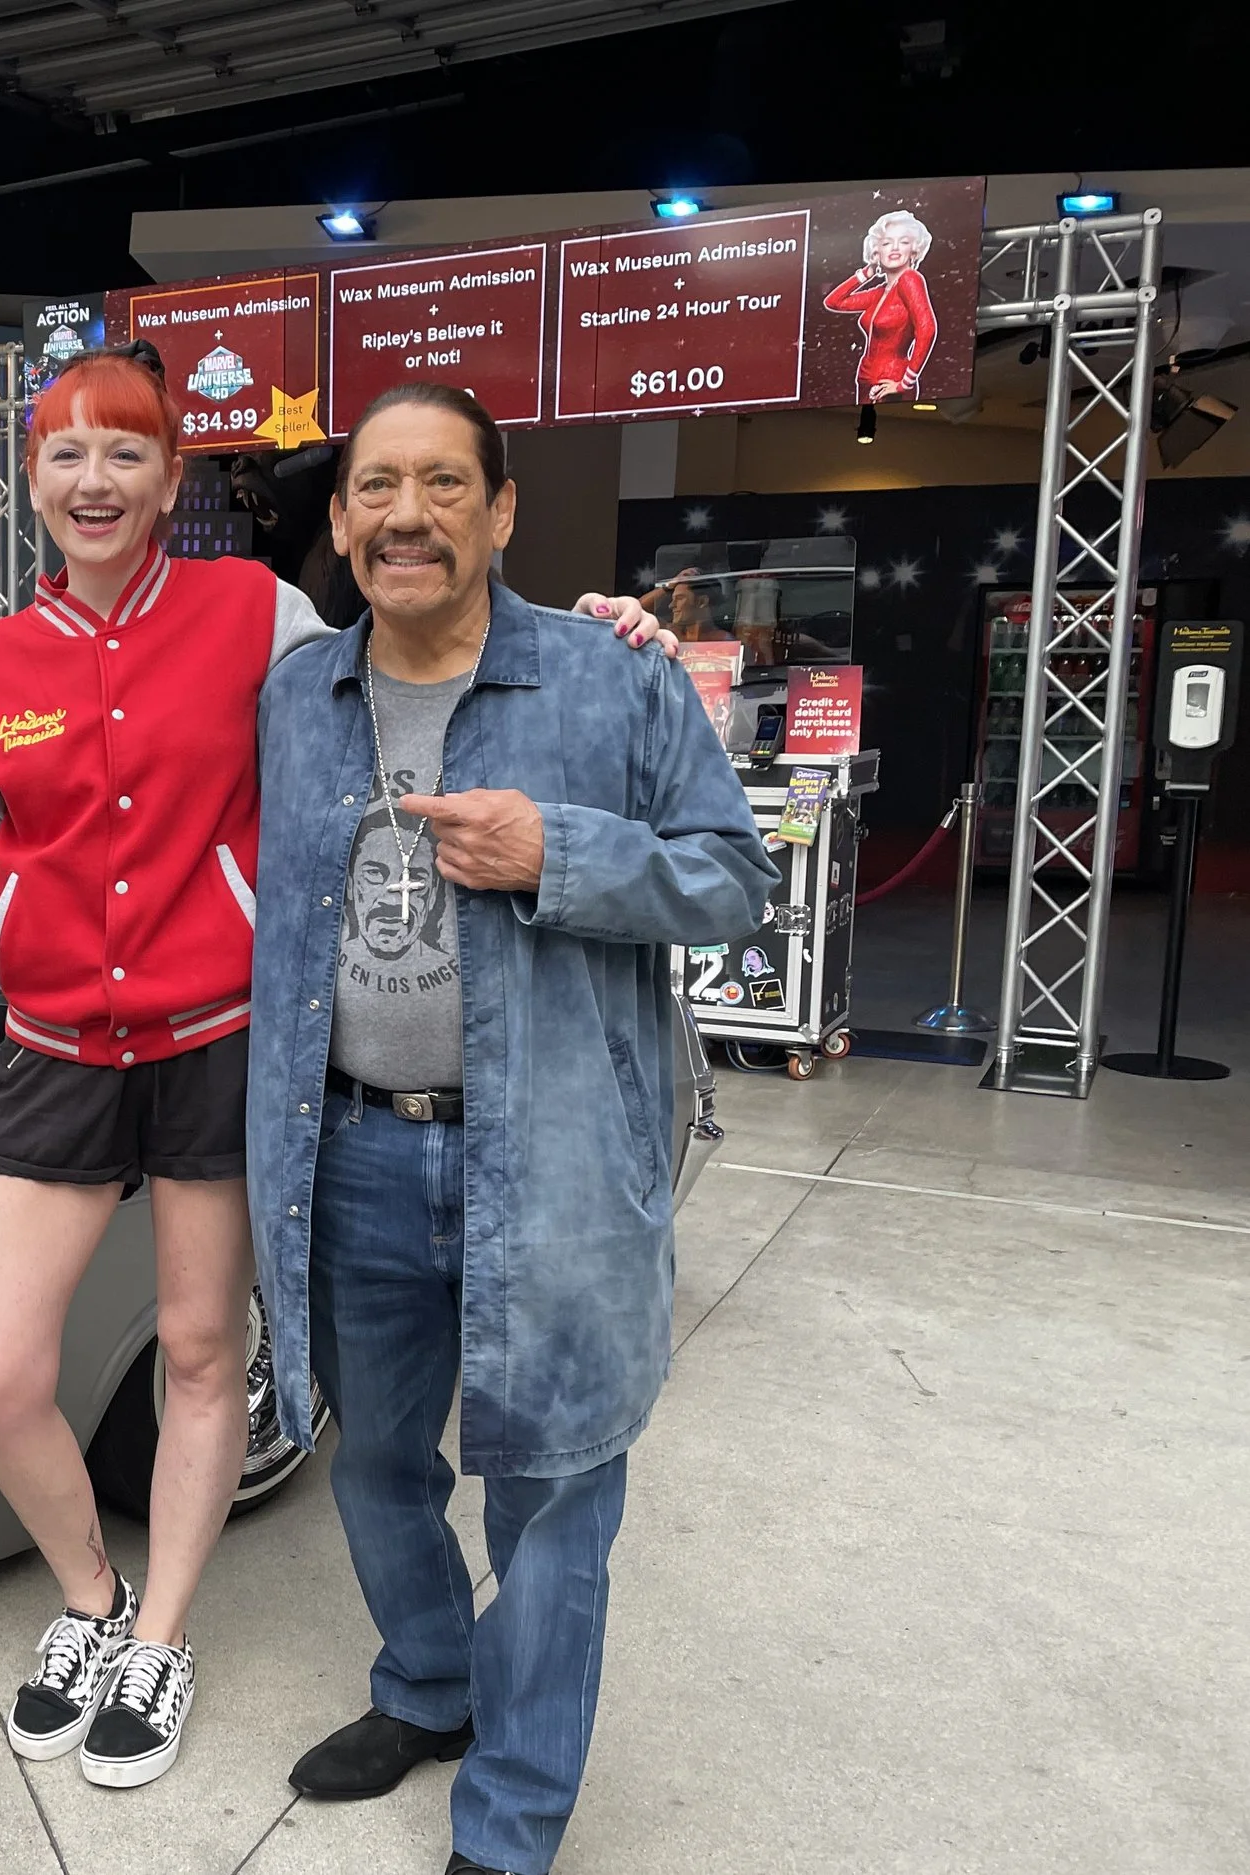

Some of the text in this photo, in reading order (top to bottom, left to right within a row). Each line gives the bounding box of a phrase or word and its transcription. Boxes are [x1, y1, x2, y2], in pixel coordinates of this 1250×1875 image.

[570, 237, 797, 278] Wax Museum Admission
[339, 267, 535, 303] Wax Museum Admission
[36, 307, 90, 327] ACTION
[137, 295, 310, 328] Wax Museum Admission
[580, 293, 782, 328] Starline 24 Hour Tour
[362, 320, 503, 350] Ripley's Believe it
[42, 339, 85, 355] UNIVERSE
[57, 352, 69, 360] 4D
[204, 355, 236, 372] MARVEL
[405, 348, 461, 368] or Not!
[187, 368, 254, 391] UNIVERSE
[630, 365, 724, 398] $61.00
[211, 387, 229, 400] 4D
[278, 405, 303, 416] Best
[182, 408, 258, 436] $34.99
[275, 422, 310, 433] Seller!
[799, 697, 849, 707] Credit or
[794, 707, 852, 717] debit card
[794, 717, 851, 728] purchases
[789, 728, 854, 738] only please.
[790, 778, 819, 786] Believe
[350, 960, 370, 986] EN
[377, 974, 411, 994] LOS
